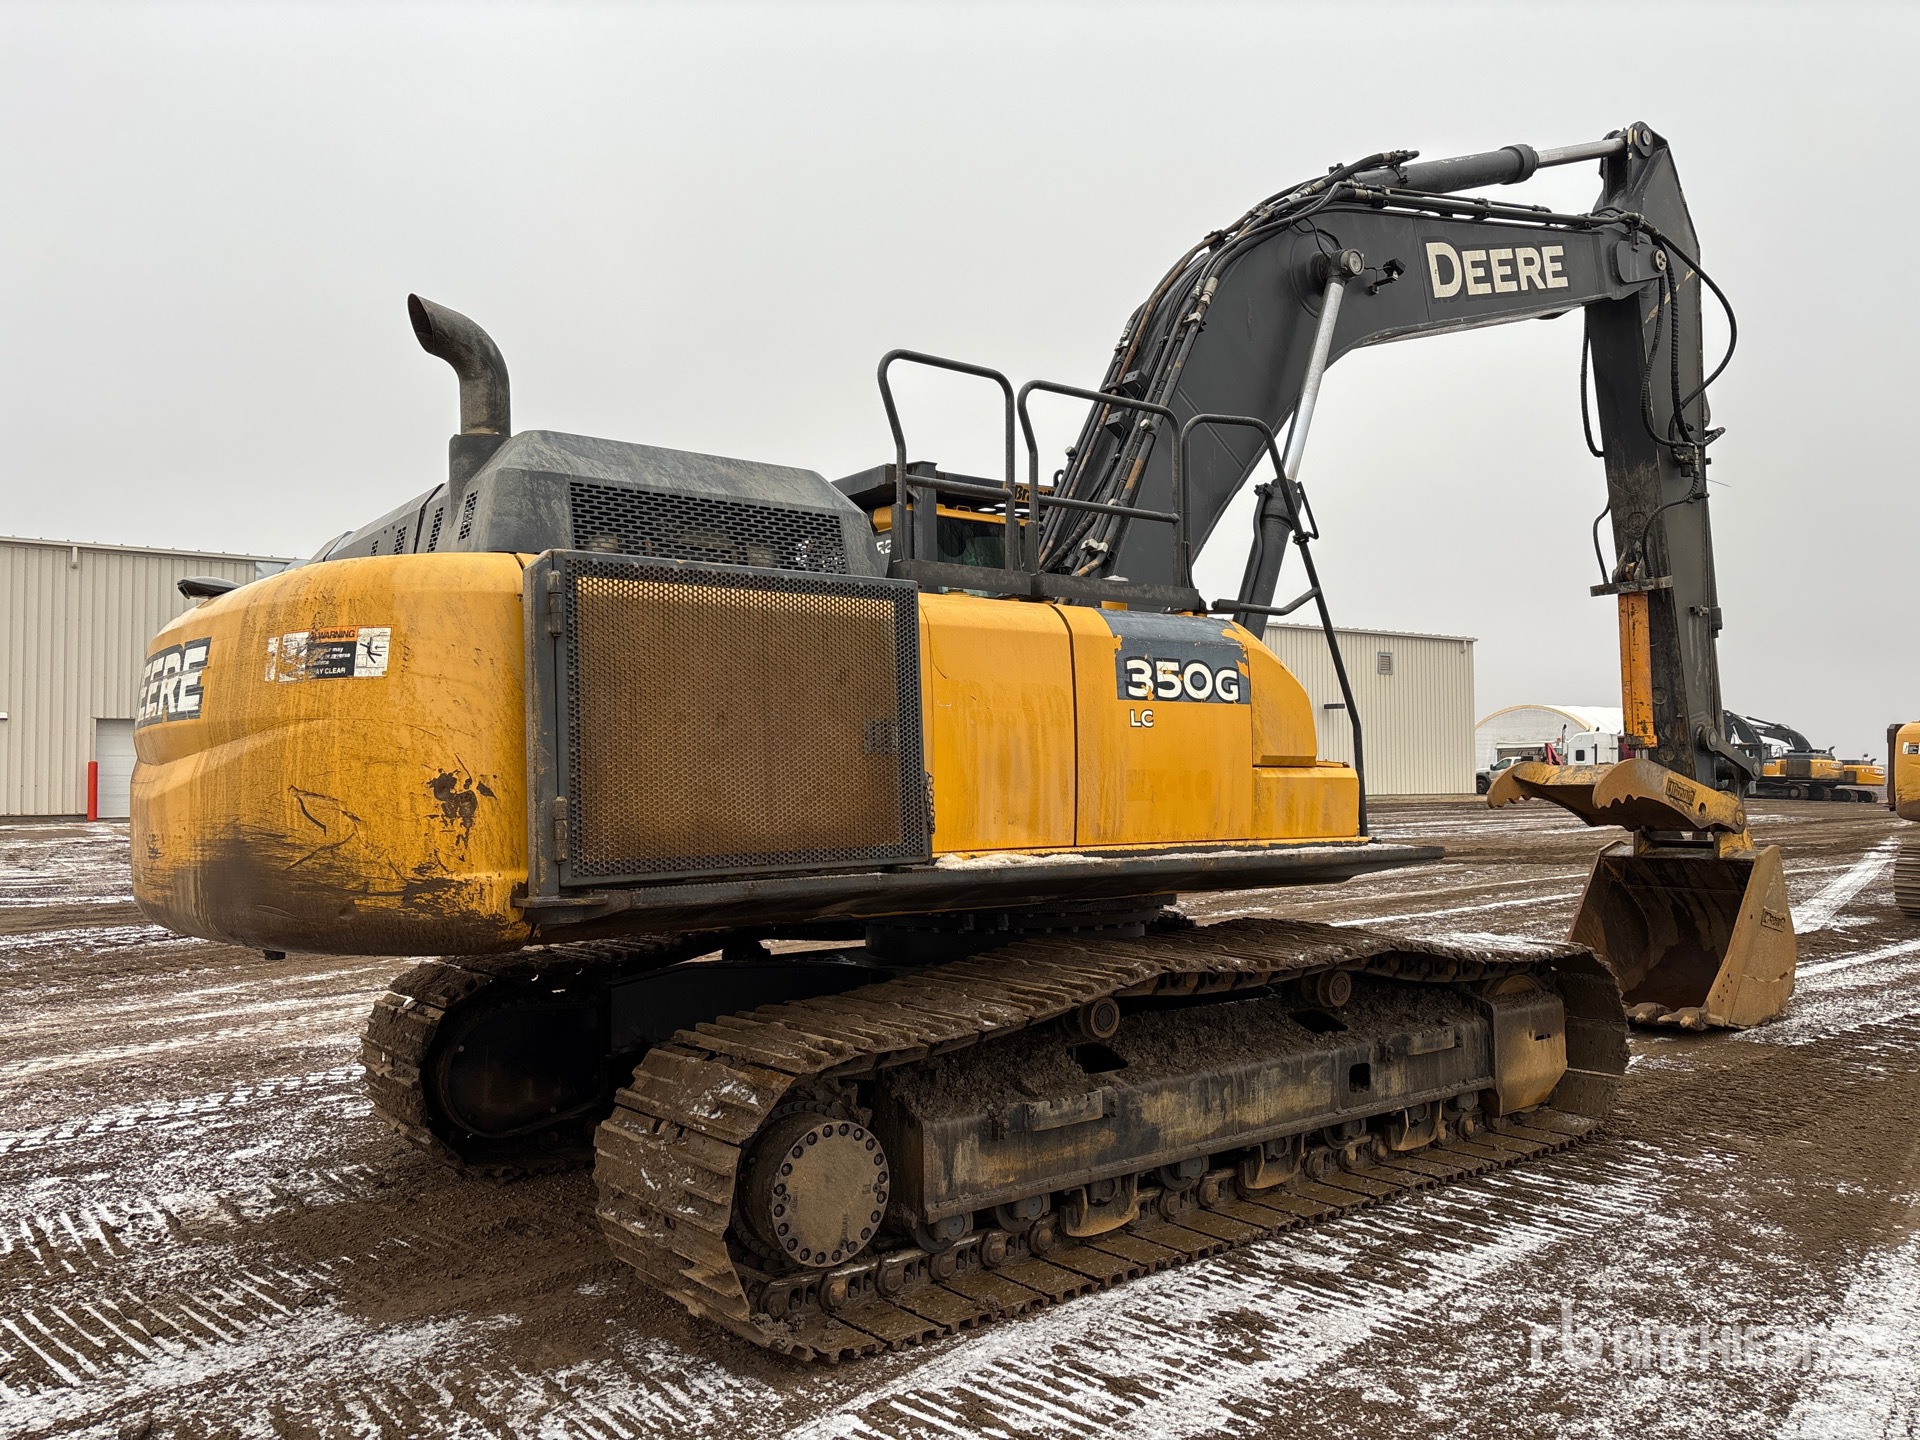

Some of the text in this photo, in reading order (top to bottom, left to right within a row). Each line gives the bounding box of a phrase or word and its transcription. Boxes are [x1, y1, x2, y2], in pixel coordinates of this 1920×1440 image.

[1426, 242, 1569, 299] DEERE
[318, 629, 356, 639] WARNING
[324, 667, 347, 675] CLEAR
[1125, 657, 1241, 702] 350G
[1129, 708, 1154, 728] LC
